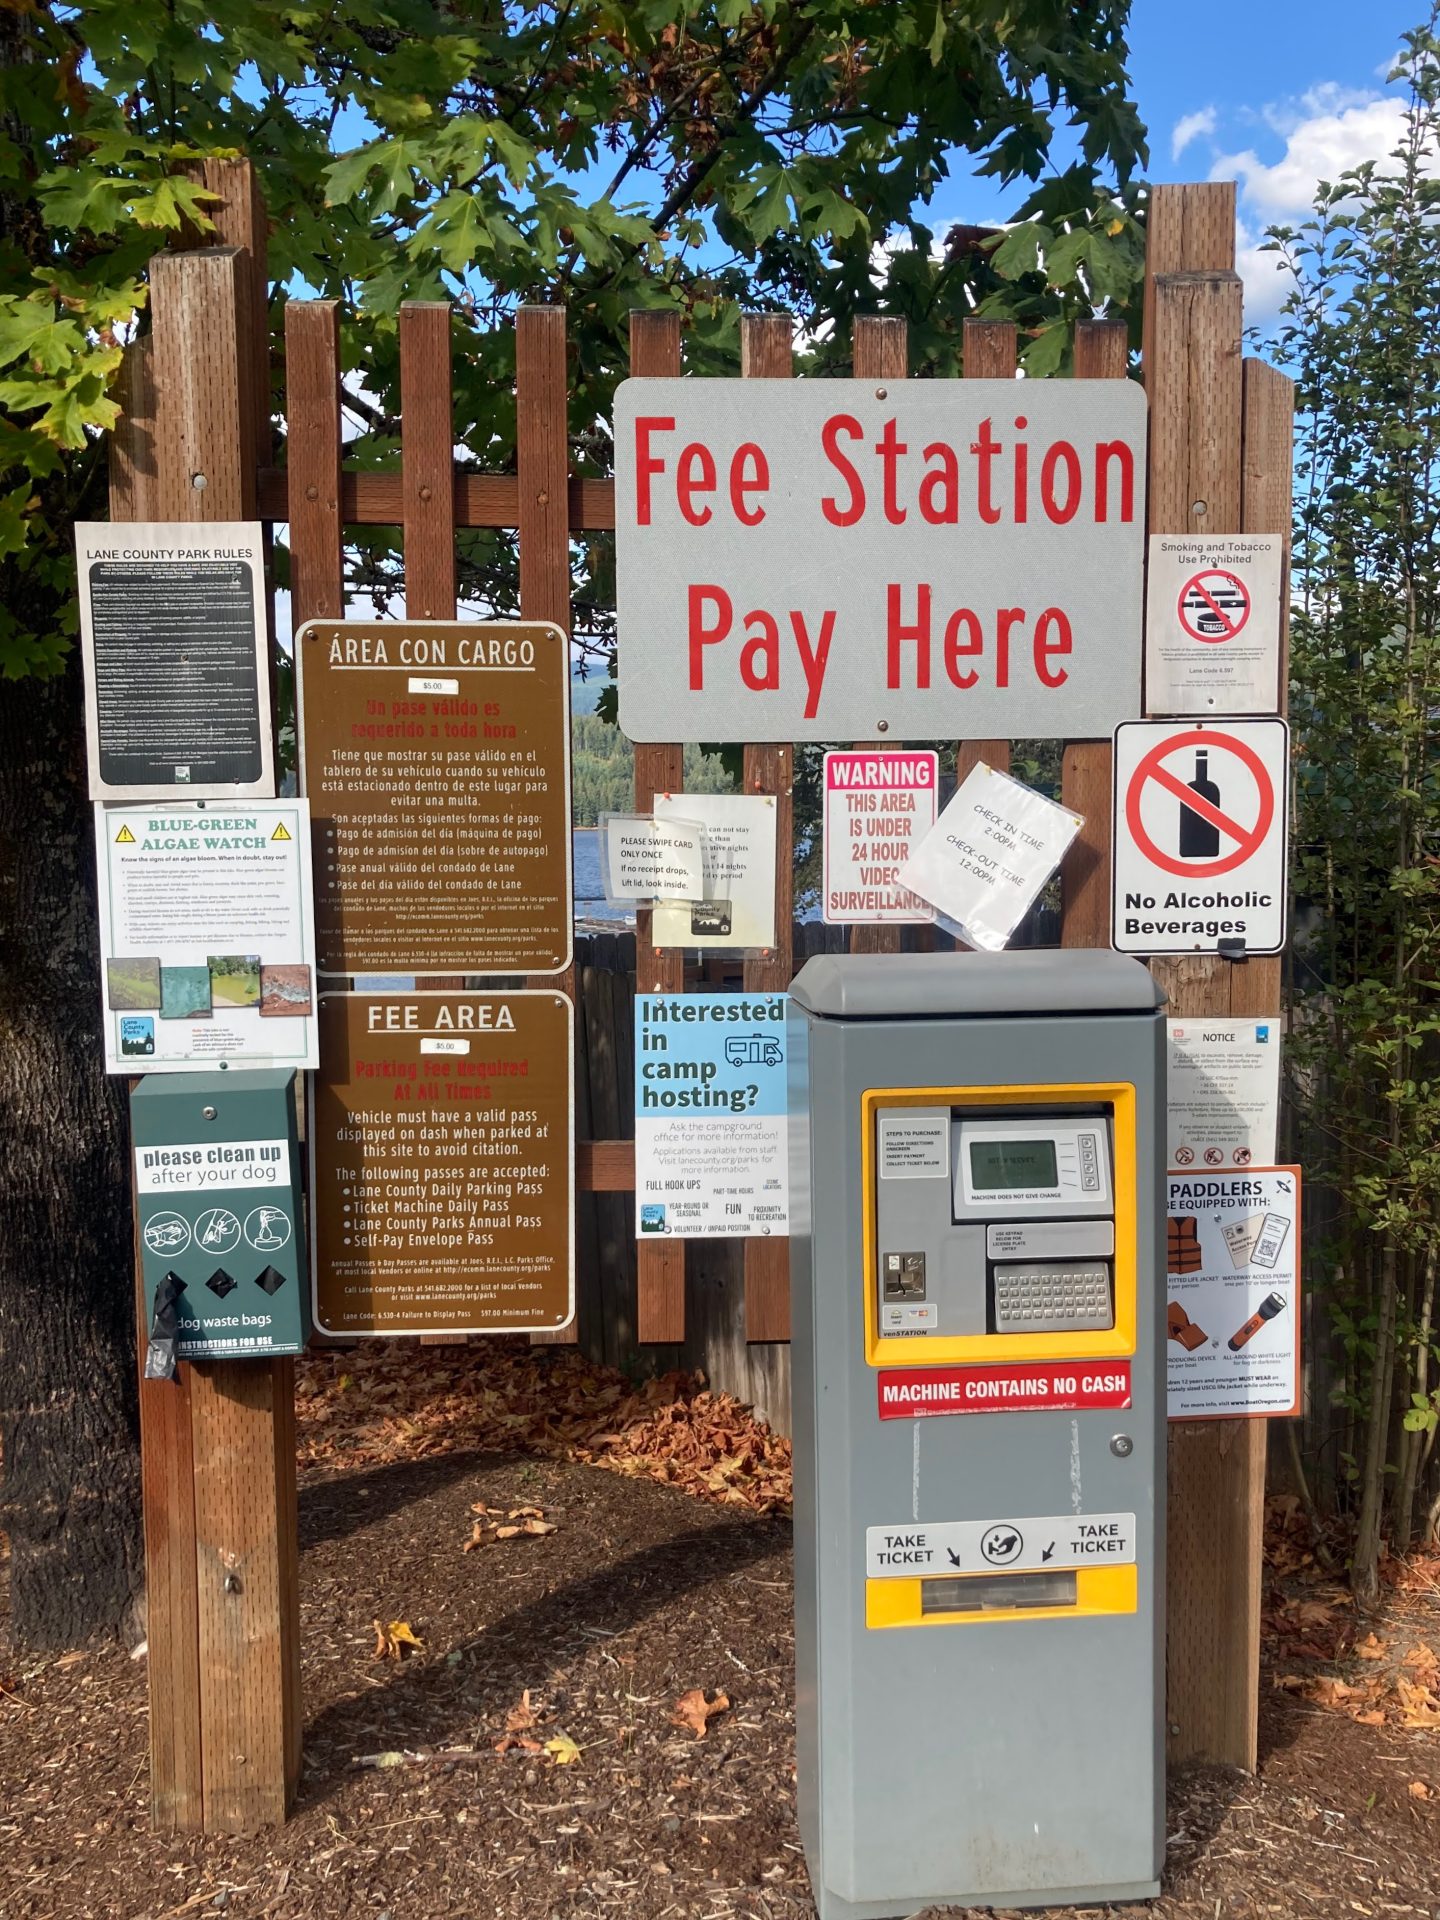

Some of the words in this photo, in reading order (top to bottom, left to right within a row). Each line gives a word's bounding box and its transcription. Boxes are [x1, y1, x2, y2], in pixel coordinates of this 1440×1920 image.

[635, 416, 770, 526] Fee
[821, 414, 1134, 527] Station
[87, 549, 119, 559] LANE
[123, 550, 174, 559] COUNTY
[178, 549, 211, 559] PARK
[214, 548, 253, 559] RULES
[1161, 543, 1203, 554] Smoking
[1206, 542, 1225, 551] and
[1227, 542, 1271, 551] Tobacco
[1178, 555, 1197, 564] Use
[1200, 554, 1251, 564] Prohibited
[1203, 624, 1226, 632] TOBACCO
[329, 634, 388, 663] ÁREA
[400, 639, 445, 664] CON
[458, 640, 534, 665] CARGO
[688, 584, 837, 719] Pay
[887, 583, 1073, 689] Here
[423, 682, 442, 690] $5.00
[391, 700, 427, 720] pase
[432, 699, 478, 716] válido
[483, 702, 500, 717] es
[430, 724, 439, 738] a
[444, 722, 478, 738] toda
[482, 722, 517, 739] hora
[332, 749, 360, 761] Tiene
[364, 751, 383, 763] que
[387, 750, 427, 761] mostrar
[431, 752, 443, 761] su
[447, 752, 470, 764] pase
[474, 749, 506, 761] válido
[510, 752, 522, 761] en
[526, 750, 536, 761] el
[833, 761, 929, 786] WARNING
[845, 794, 877, 812] THIS
[880, 793, 916, 812] AREA
[148, 819, 257, 831] BLUE-GREEN
[850, 818, 864, 836] IS
[866, 818, 911, 836] UNDER
[974, 805, 1003, 826] CHECK
[1004, 823, 1018, 835] IN
[1020, 831, 1045, 850] TIME
[141, 838, 200, 850] ALGAE
[203, 837, 266, 849] WATCH
[621, 837, 646, 845] PLEASE
[648, 839, 672, 847] SWIPE
[674, 840, 693, 849] CARD
[984, 827, 1016, 851] 2:00PM
[620, 850, 640, 858] ONLY
[641, 851, 662, 859] ONCE
[852, 843, 868, 861] 24
[871, 842, 908, 861] HOUR
[946, 835, 998, 870] CHECK-OUT
[1001, 867, 1026, 886] TIME
[638, 866, 664, 874] receipt
[666, 867, 689, 876] drops,
[959, 858, 996, 885] 12:00PM
[633, 880, 644, 888] lid,
[664, 881, 688, 889] inside.
[1126, 893, 1156, 909] No
[1163, 891, 1271, 909] Alcoholic
[1125, 919, 1246, 937] Beverages
[369, 1006, 419, 1029] FEE
[434, 1005, 514, 1029] AREA
[643, 998, 784, 1022] Interested
[436, 1042, 454, 1050] $5.00
[642, 1028, 667, 1051] in
[1203, 1033, 1235, 1042] NOTICE
[355, 1060, 417, 1080] Parking
[423, 1060, 451, 1077] Fee
[642, 1062, 716, 1084] camp
[394, 1084, 411, 1101] At
[417, 1084, 439, 1100] All
[445, 1083, 492, 1100] Times
[643, 1084, 759, 1112] hosting?
[346, 1111, 392, 1125] Vehicle
[397, 1110, 426, 1123] must
[431, 1110, 460, 1123] have
[464, 1112, 471, 1122] a
[476, 1110, 506, 1122] valid
[511, 1111, 537, 1124] pass
[337, 1127, 395, 1144] displayed
[400, 1129, 415, 1140] on
[420, 1126, 448, 1140] dash
[453, 1126, 485, 1139] when
[490, 1125, 531, 1142] parked
[536, 1125, 548, 1138] at
[144, 1151, 202, 1169] please
[207, 1148, 255, 1164] clean
[260, 1147, 281, 1162] up
[363, 1144, 386, 1157] this
[391, 1144, 413, 1157] site
[418, 1143, 430, 1156] to
[435, 1143, 467, 1156] avoid
[472, 1142, 522, 1155] citation.
[152, 1170, 192, 1184] after
[197, 1169, 237, 1186] your
[242, 1165, 276, 1181] dog
[336, 1167, 357, 1181] The
[361, 1166, 419, 1182] following
[424, 1168, 464, 1182] passes
[469, 1168, 488, 1178] are
[493, 1164, 549, 1180] accepted:
[353, 1186, 380, 1199] Lane
[386, 1184, 427, 1199] County
[432, 1184, 462, 1199] Daily
[467, 1183, 511, 1198] Parking
[517, 1183, 543, 1196] Pass
[646, 1181, 663, 1190] FULL
[665, 1180, 684, 1190] HOOK
[686, 1180, 701, 1190] UPS
[1170, 1181, 1262, 1198] PADDLERS
[353, 1202, 389, 1214] Ticket
[394, 1200, 443, 1213] Machine
[448, 1199, 478, 1215] Daily
[483, 1199, 509, 1211] Pass
[726, 1203, 741, 1215] FUN
[1179, 1199, 1235, 1210] EQUIPPED
[1238, 1198, 1271, 1207] WITH:
[177, 1316, 200, 1331] dog
[203, 1316, 239, 1327] waste
[242, 1315, 272, 1328] bags
[240, 1337, 255, 1347] FOR
[257, 1336, 273, 1346] USE
[884, 1383, 960, 1402] MACHINE
[966, 1379, 1048, 1398] CONTAINS
[1054, 1377, 1076, 1394] NO
[1082, 1375, 1125, 1393] CASH
[1078, 1524, 1118, 1537] TAKE
[884, 1534, 926, 1548] TAKE
[1070, 1539, 1126, 1553] TICKET
[877, 1550, 934, 1565] TICKET
